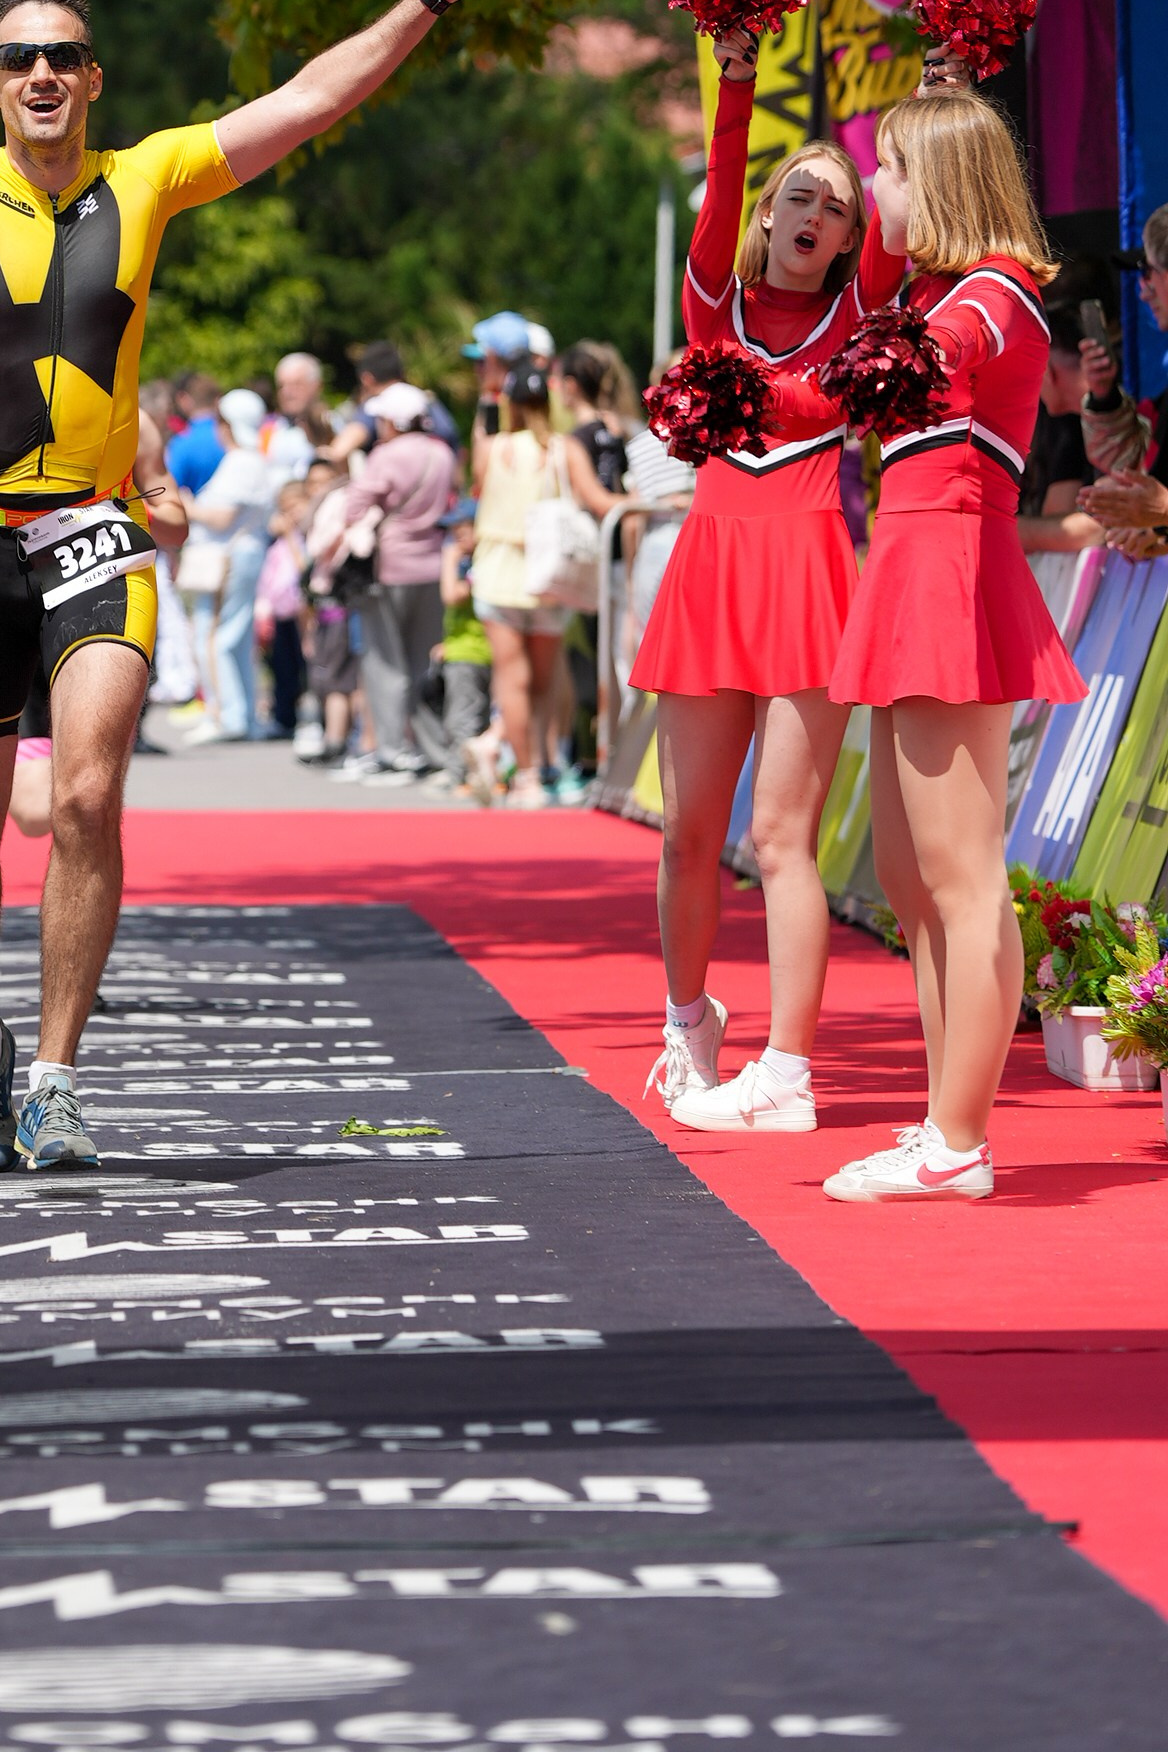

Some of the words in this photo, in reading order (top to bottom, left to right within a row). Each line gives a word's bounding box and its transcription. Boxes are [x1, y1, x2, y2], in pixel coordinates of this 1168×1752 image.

[57, 512, 75, 525] IRON
[53, 523, 132, 579] 3241
[84, 564, 119, 584] ALEKSEY
[143, 1141, 465, 1157] STAR
[162, 1224, 529, 1246] STAR
[184, 1327, 606, 1355] STAR
[205, 1475, 710, 1508] STAR
[221, 1562, 780, 1599] STAR
